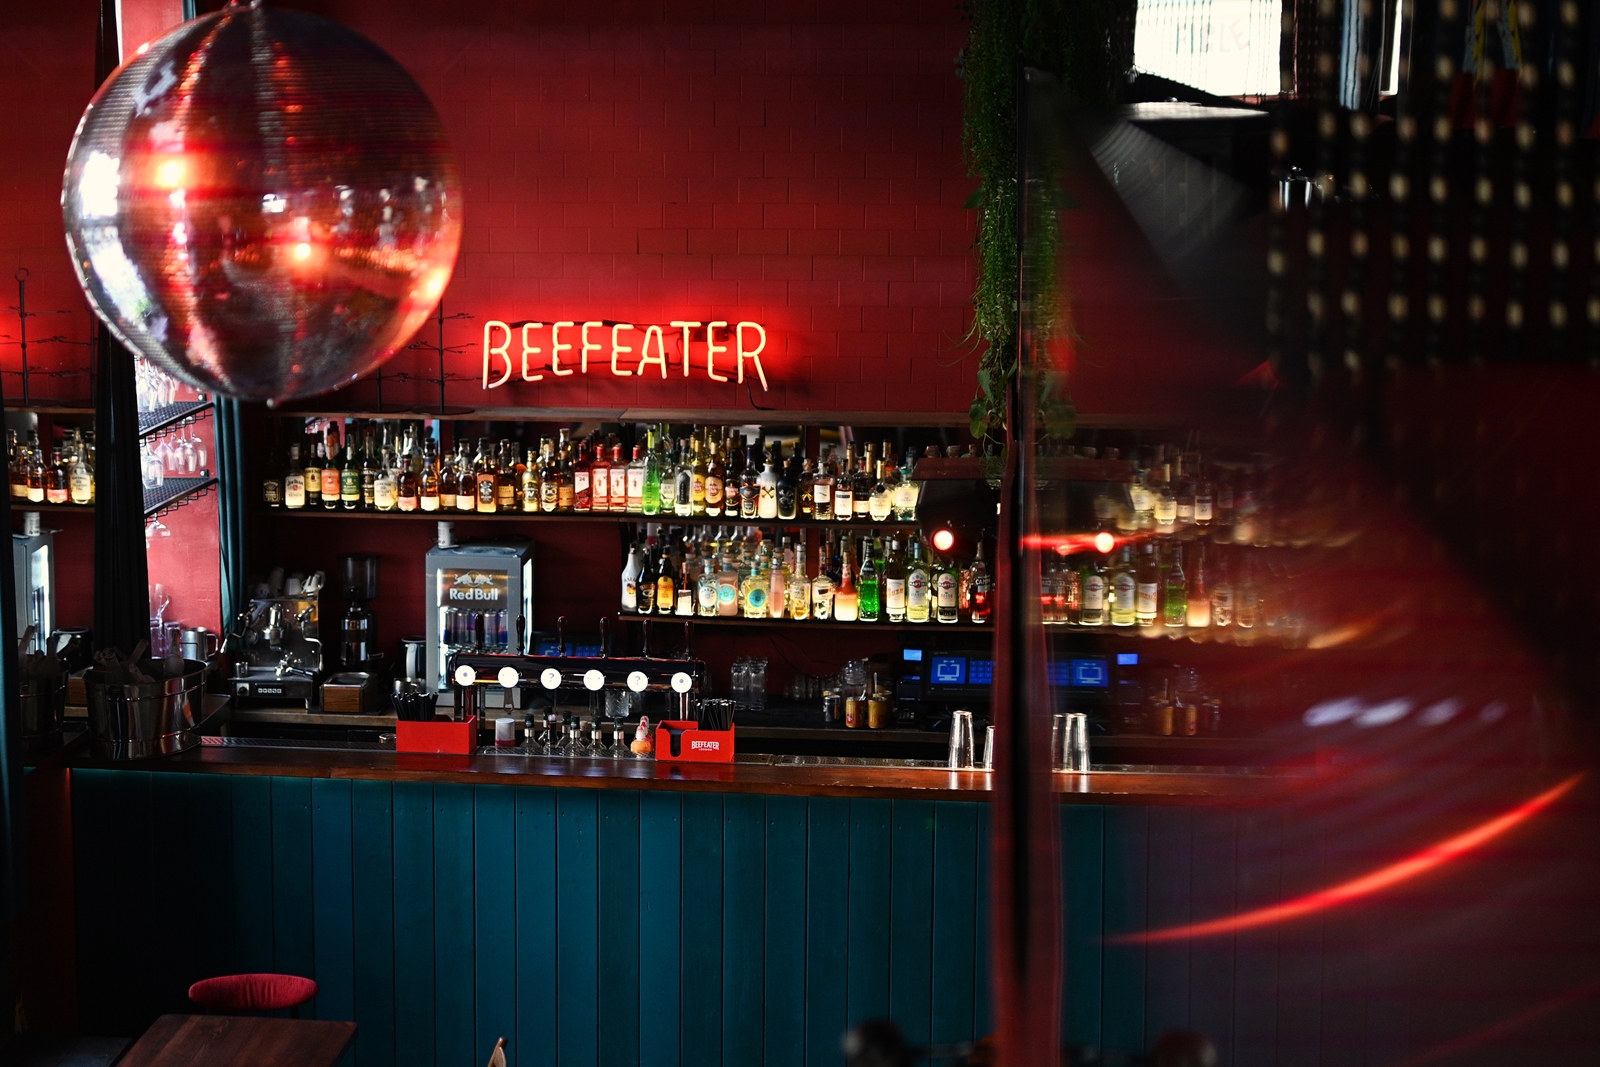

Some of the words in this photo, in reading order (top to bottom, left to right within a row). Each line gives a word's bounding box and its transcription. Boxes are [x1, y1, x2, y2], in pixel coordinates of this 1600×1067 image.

[482, 320, 769, 391] BEEFEATER
[450, 588, 473, 600] Red
[475, 588, 498, 600] Bull
[691, 740, 720, 751] BEEFEATER
